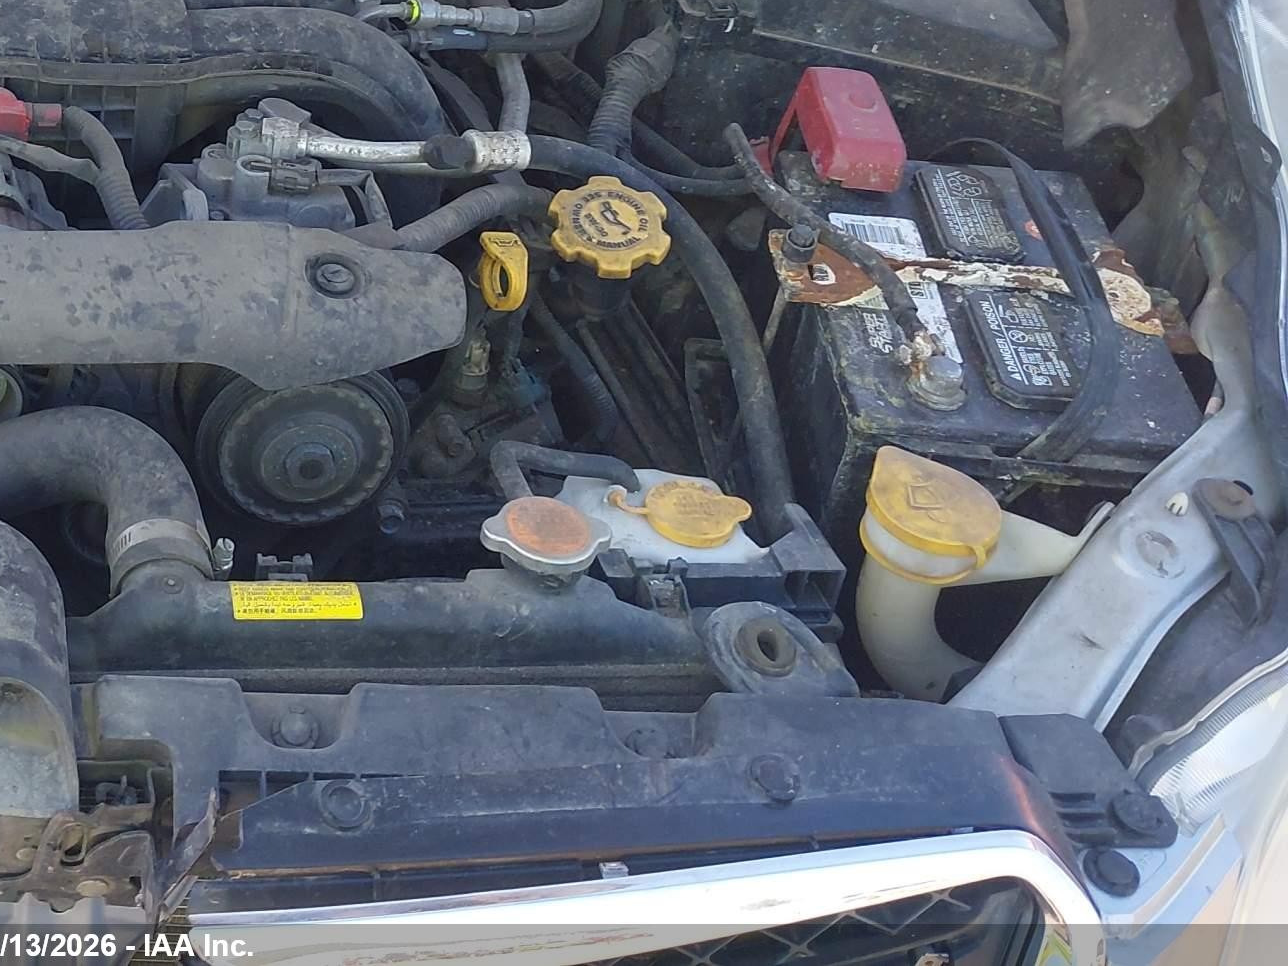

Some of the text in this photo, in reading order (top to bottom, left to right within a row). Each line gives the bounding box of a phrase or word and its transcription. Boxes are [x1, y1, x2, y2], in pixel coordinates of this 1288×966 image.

[583, 191, 602, 203] SEE
[596, 236, 641, 249] MANUAL
[607, 191, 649, 232] ENGINE OIL
[978, 300, 1002, 330] POISON
[995, 338, 1019, 372] DANGER
